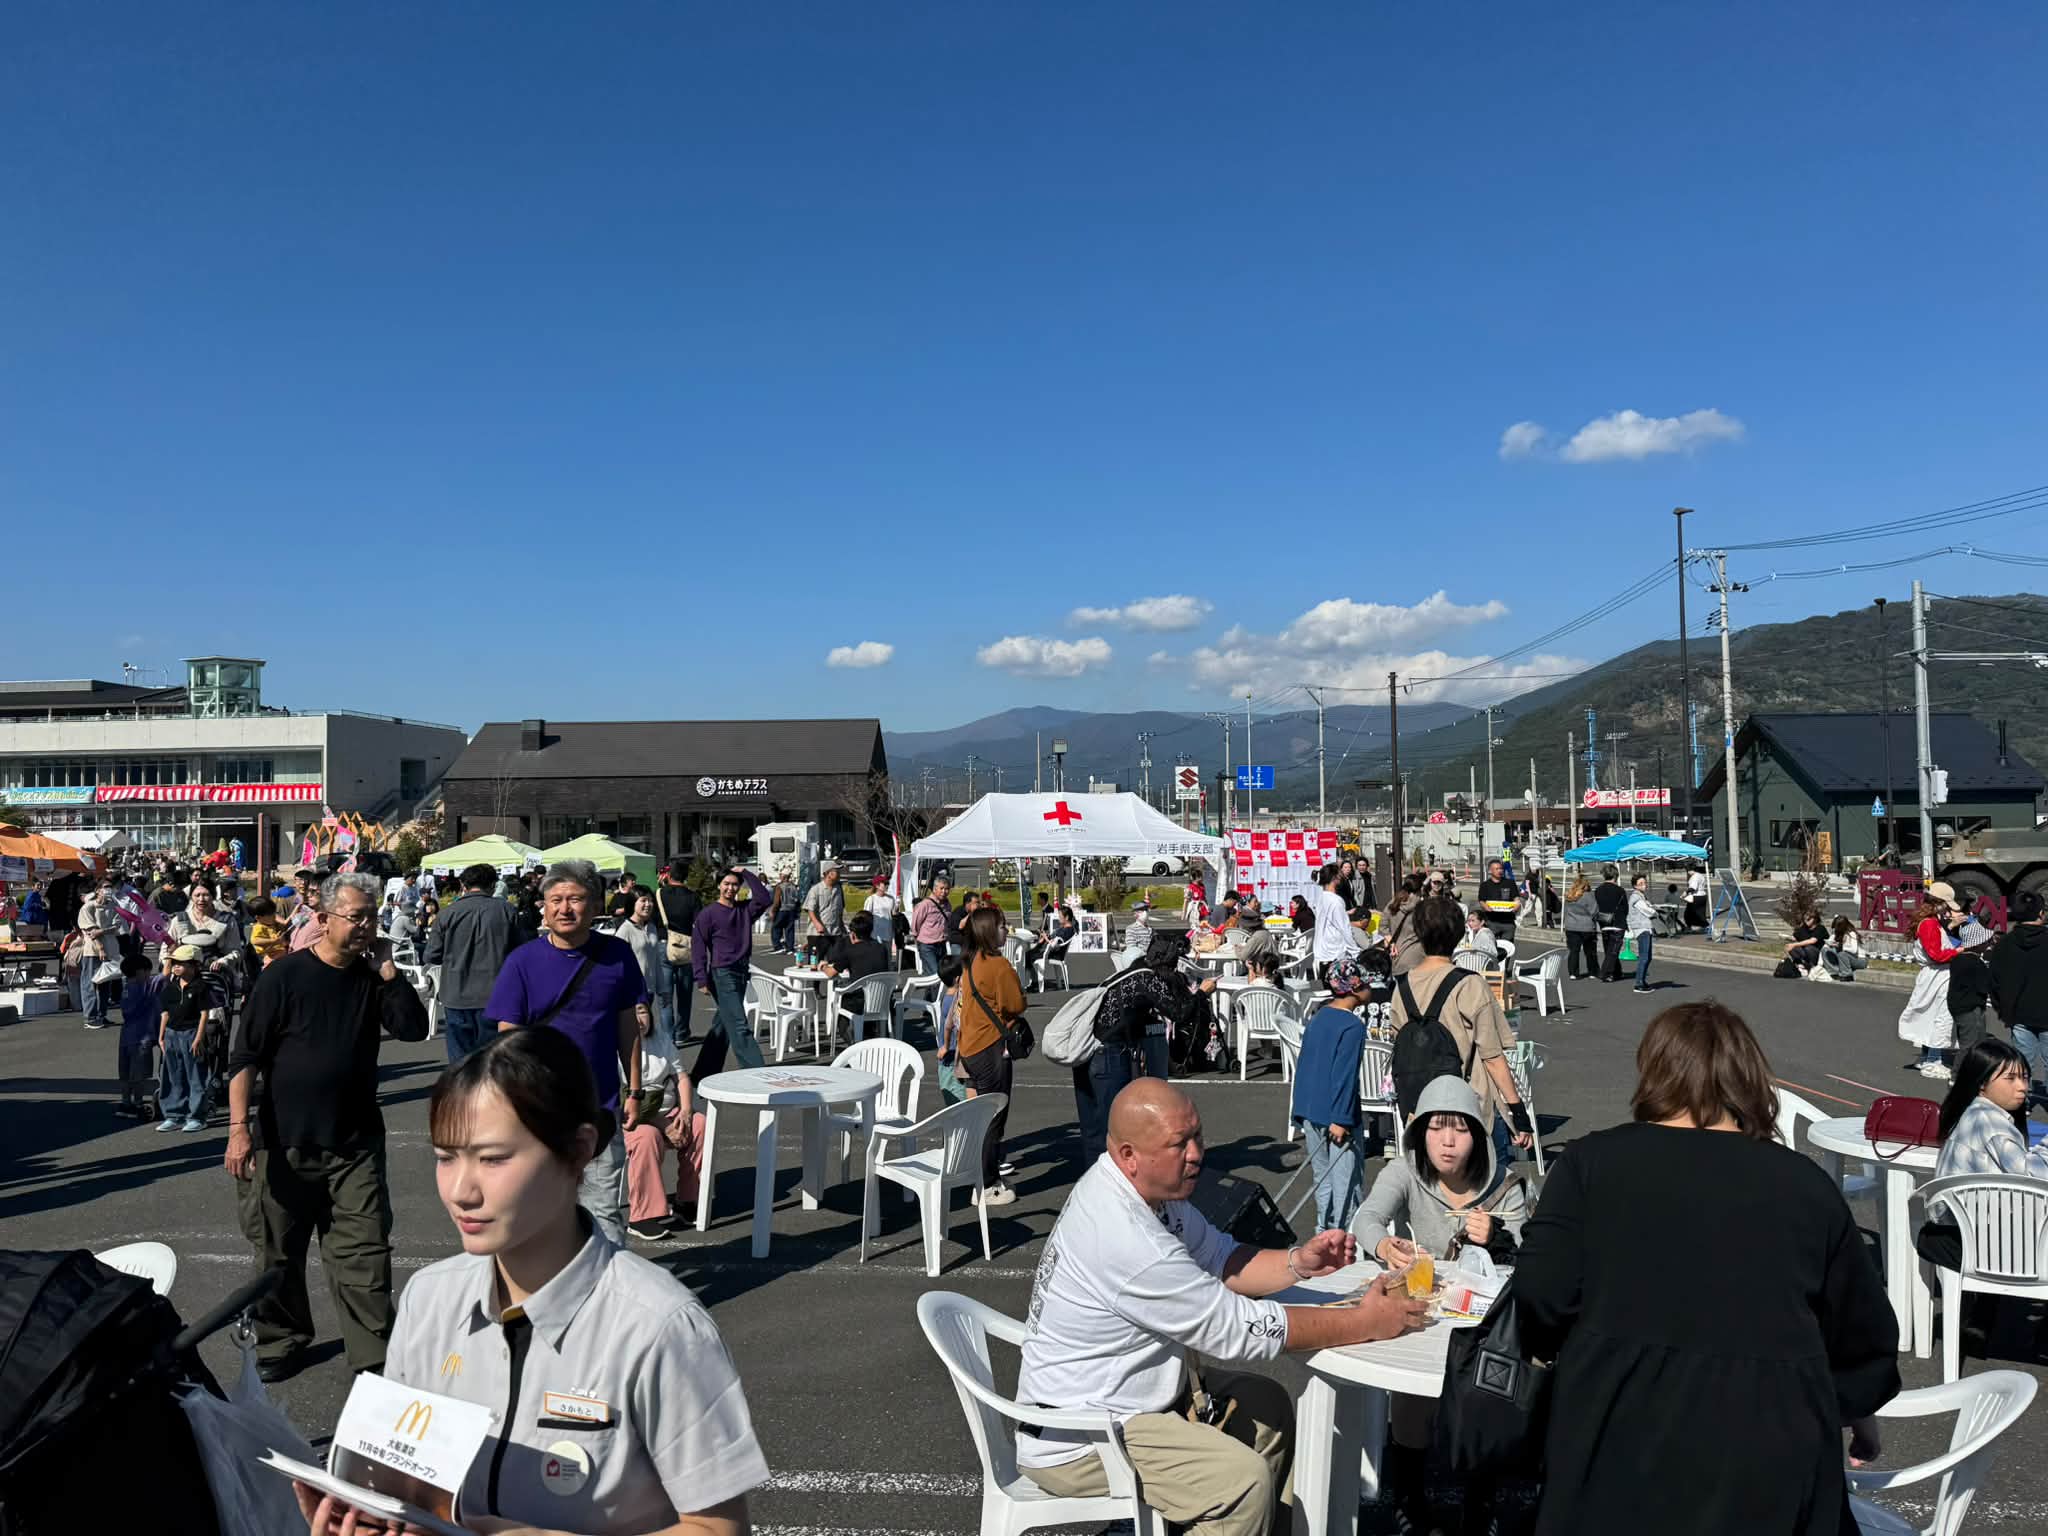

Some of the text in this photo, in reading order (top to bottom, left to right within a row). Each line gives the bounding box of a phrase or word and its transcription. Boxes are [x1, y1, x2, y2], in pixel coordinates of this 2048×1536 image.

[718, 779, 768, 790] かもめテラス
[1157, 843, 1214, 855] 岩手県支部
[560, 1403, 592, 1416] さかもと
